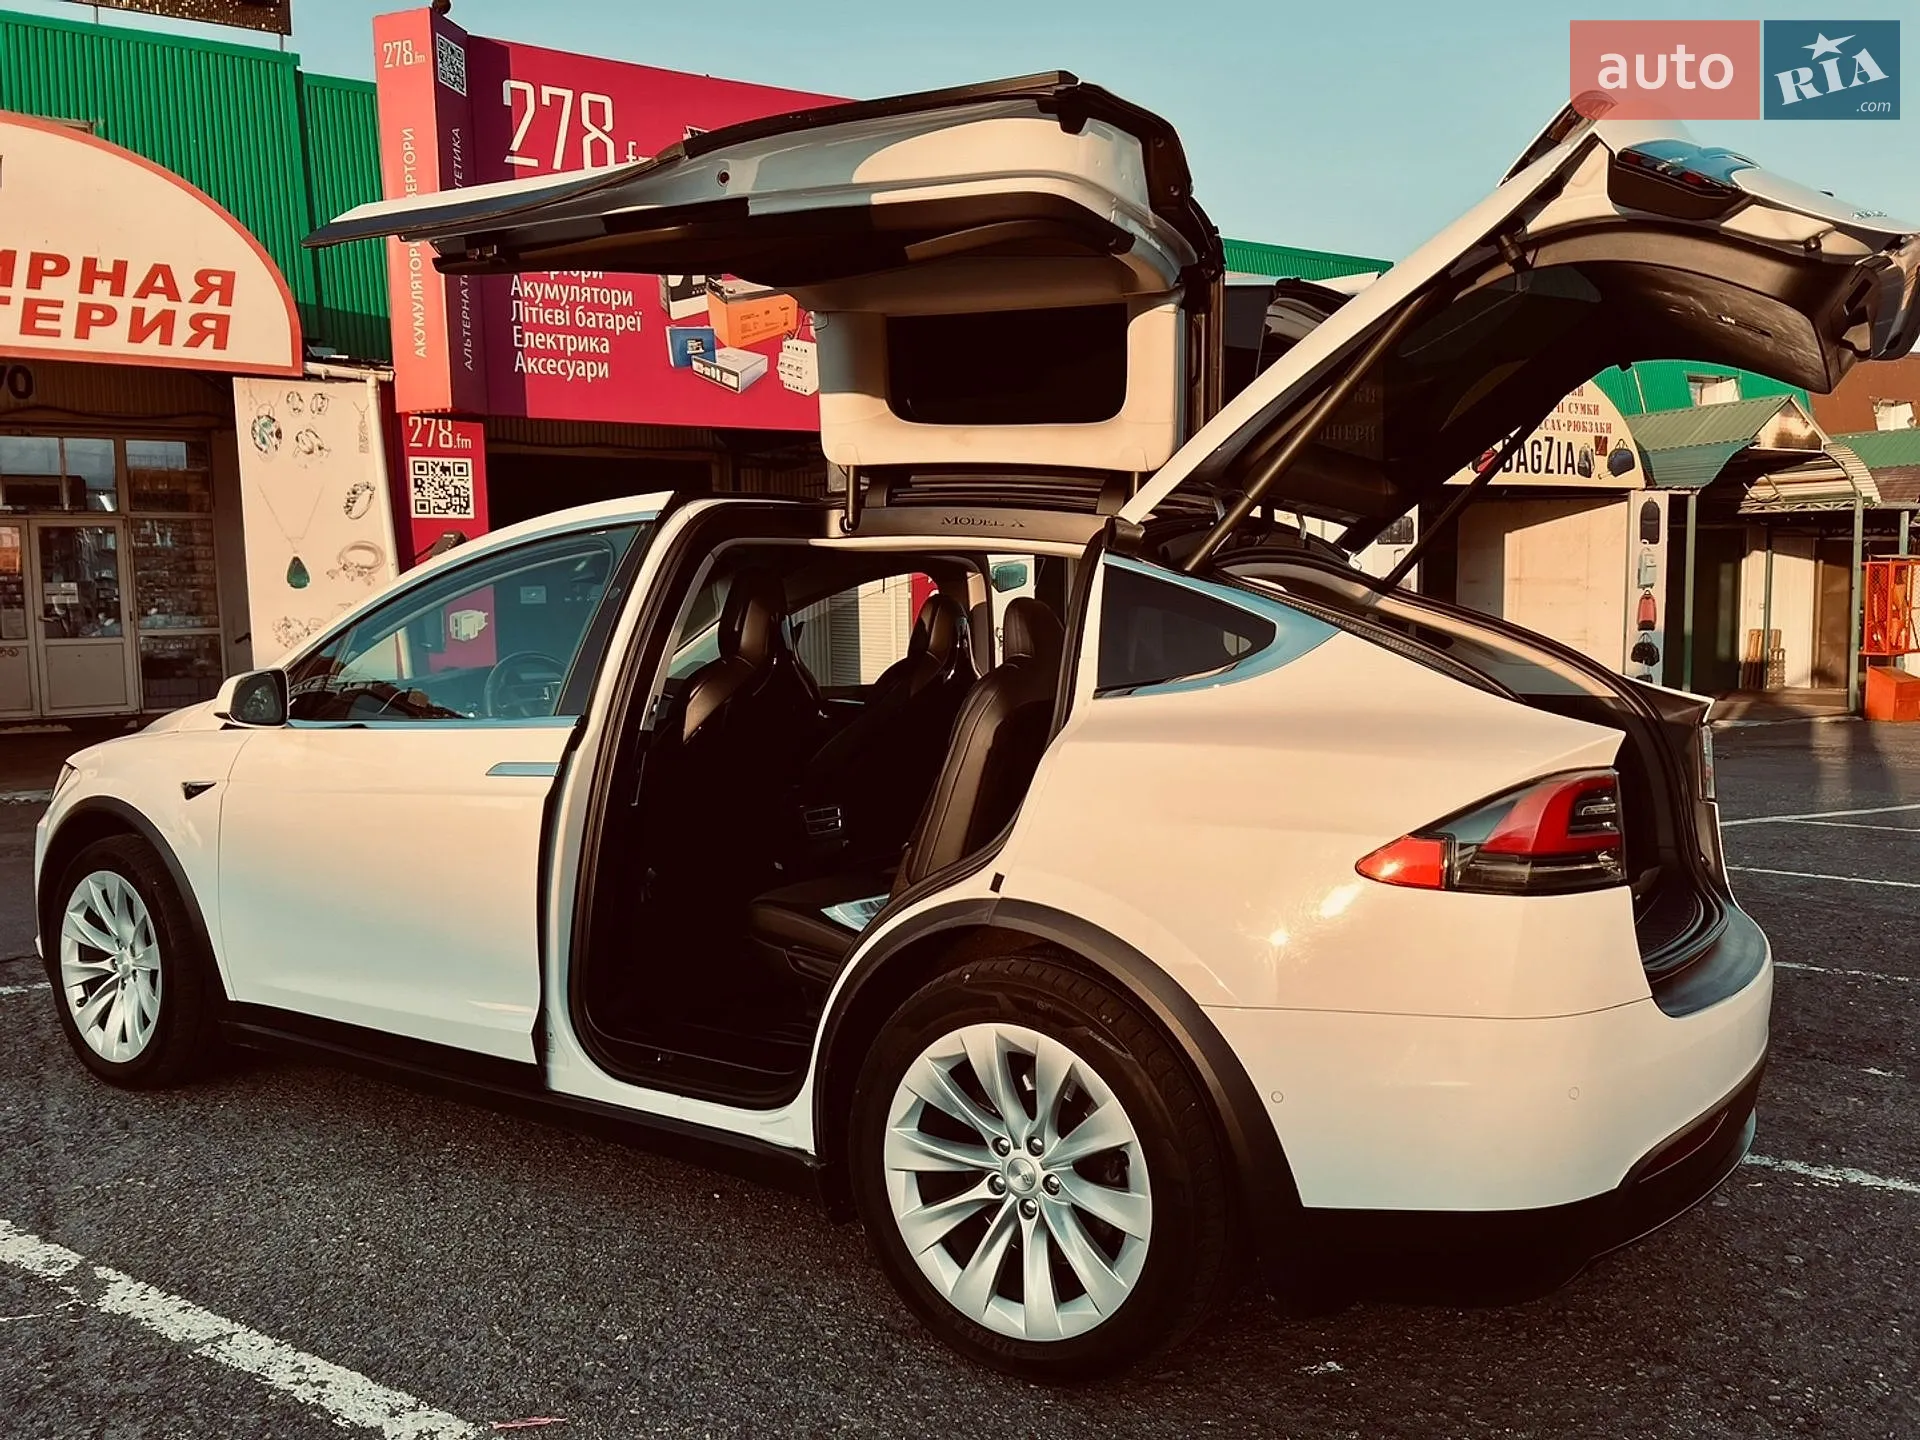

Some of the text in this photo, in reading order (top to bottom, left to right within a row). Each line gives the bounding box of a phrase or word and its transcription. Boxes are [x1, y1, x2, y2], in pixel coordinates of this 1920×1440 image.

[510, 274, 634, 311] Акумулятори
[511, 300, 643, 336] Літієві батареї
[513, 325, 611, 357] Електрика
[514, 351, 609, 384] Аксесуари
[408, 416, 472, 449] 278.fm
